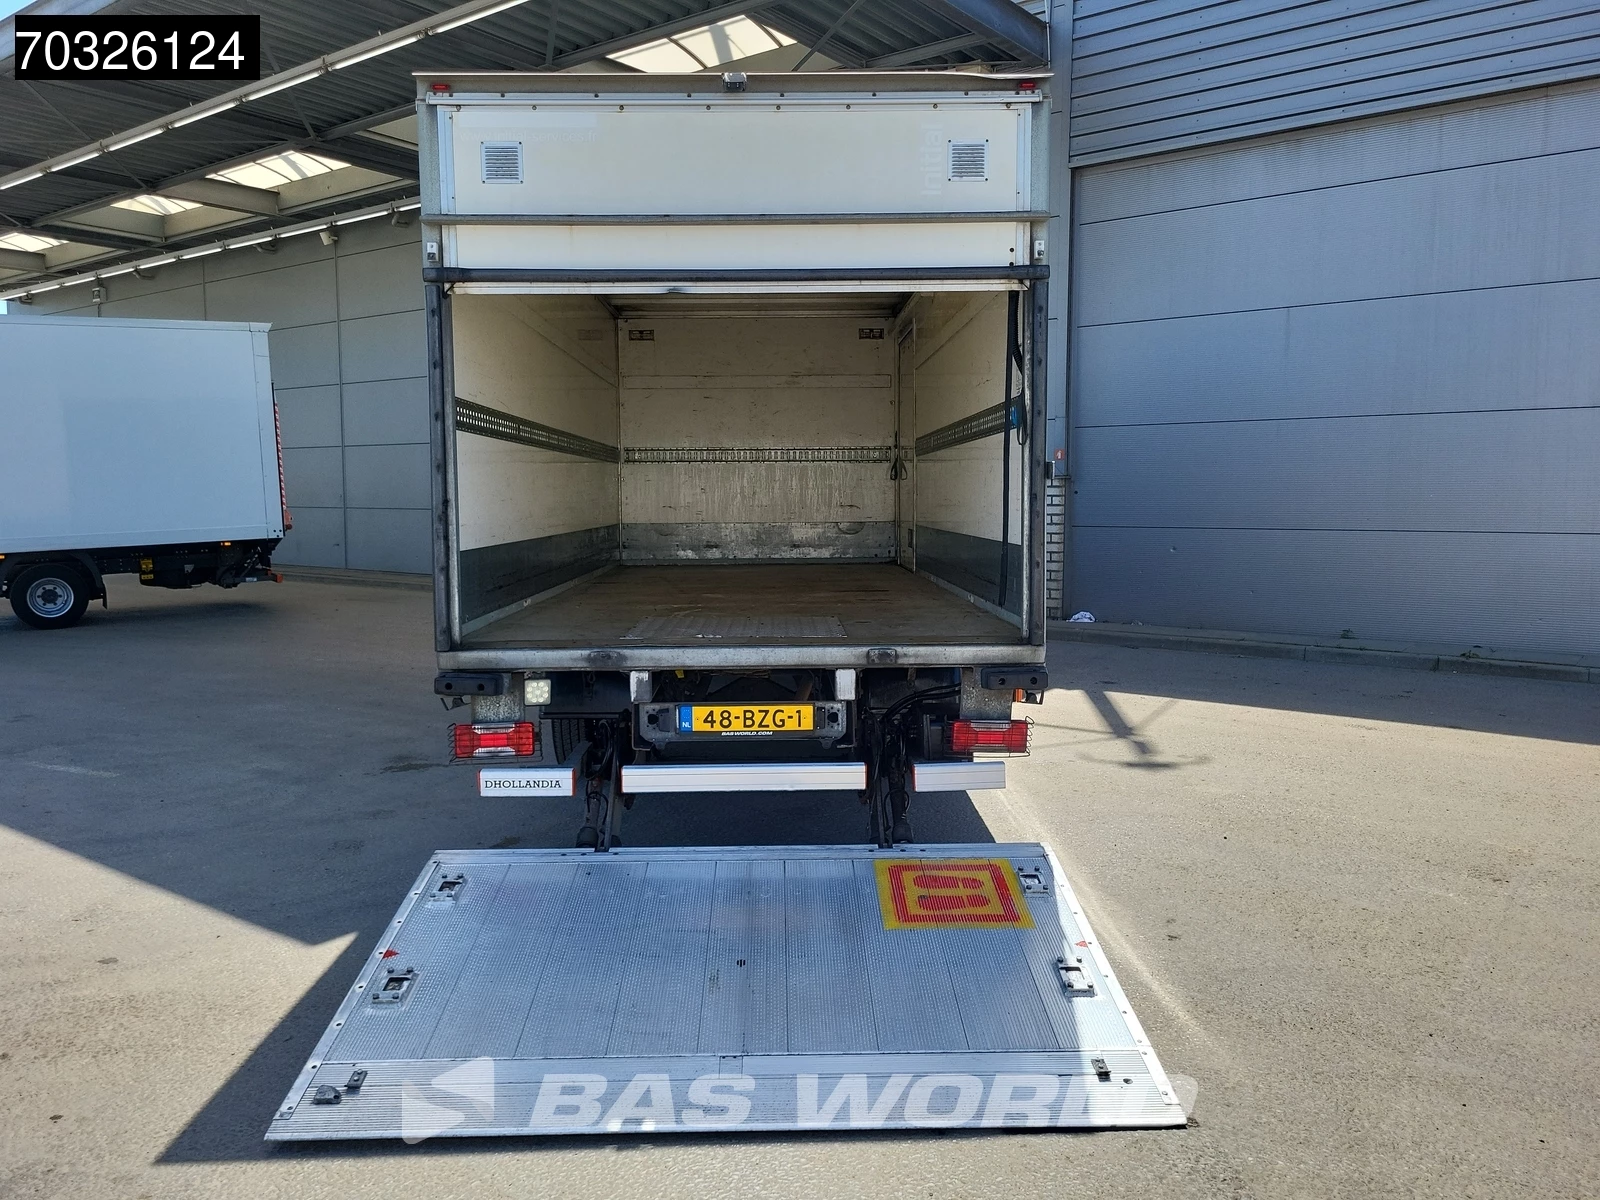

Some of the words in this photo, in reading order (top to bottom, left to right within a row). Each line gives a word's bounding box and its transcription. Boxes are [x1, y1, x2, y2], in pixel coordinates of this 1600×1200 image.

[920, 123, 943, 196] Initial
[703, 709, 802, 729] 48-BZG-1
[484, 780, 562, 788] DHOLLANDIA
